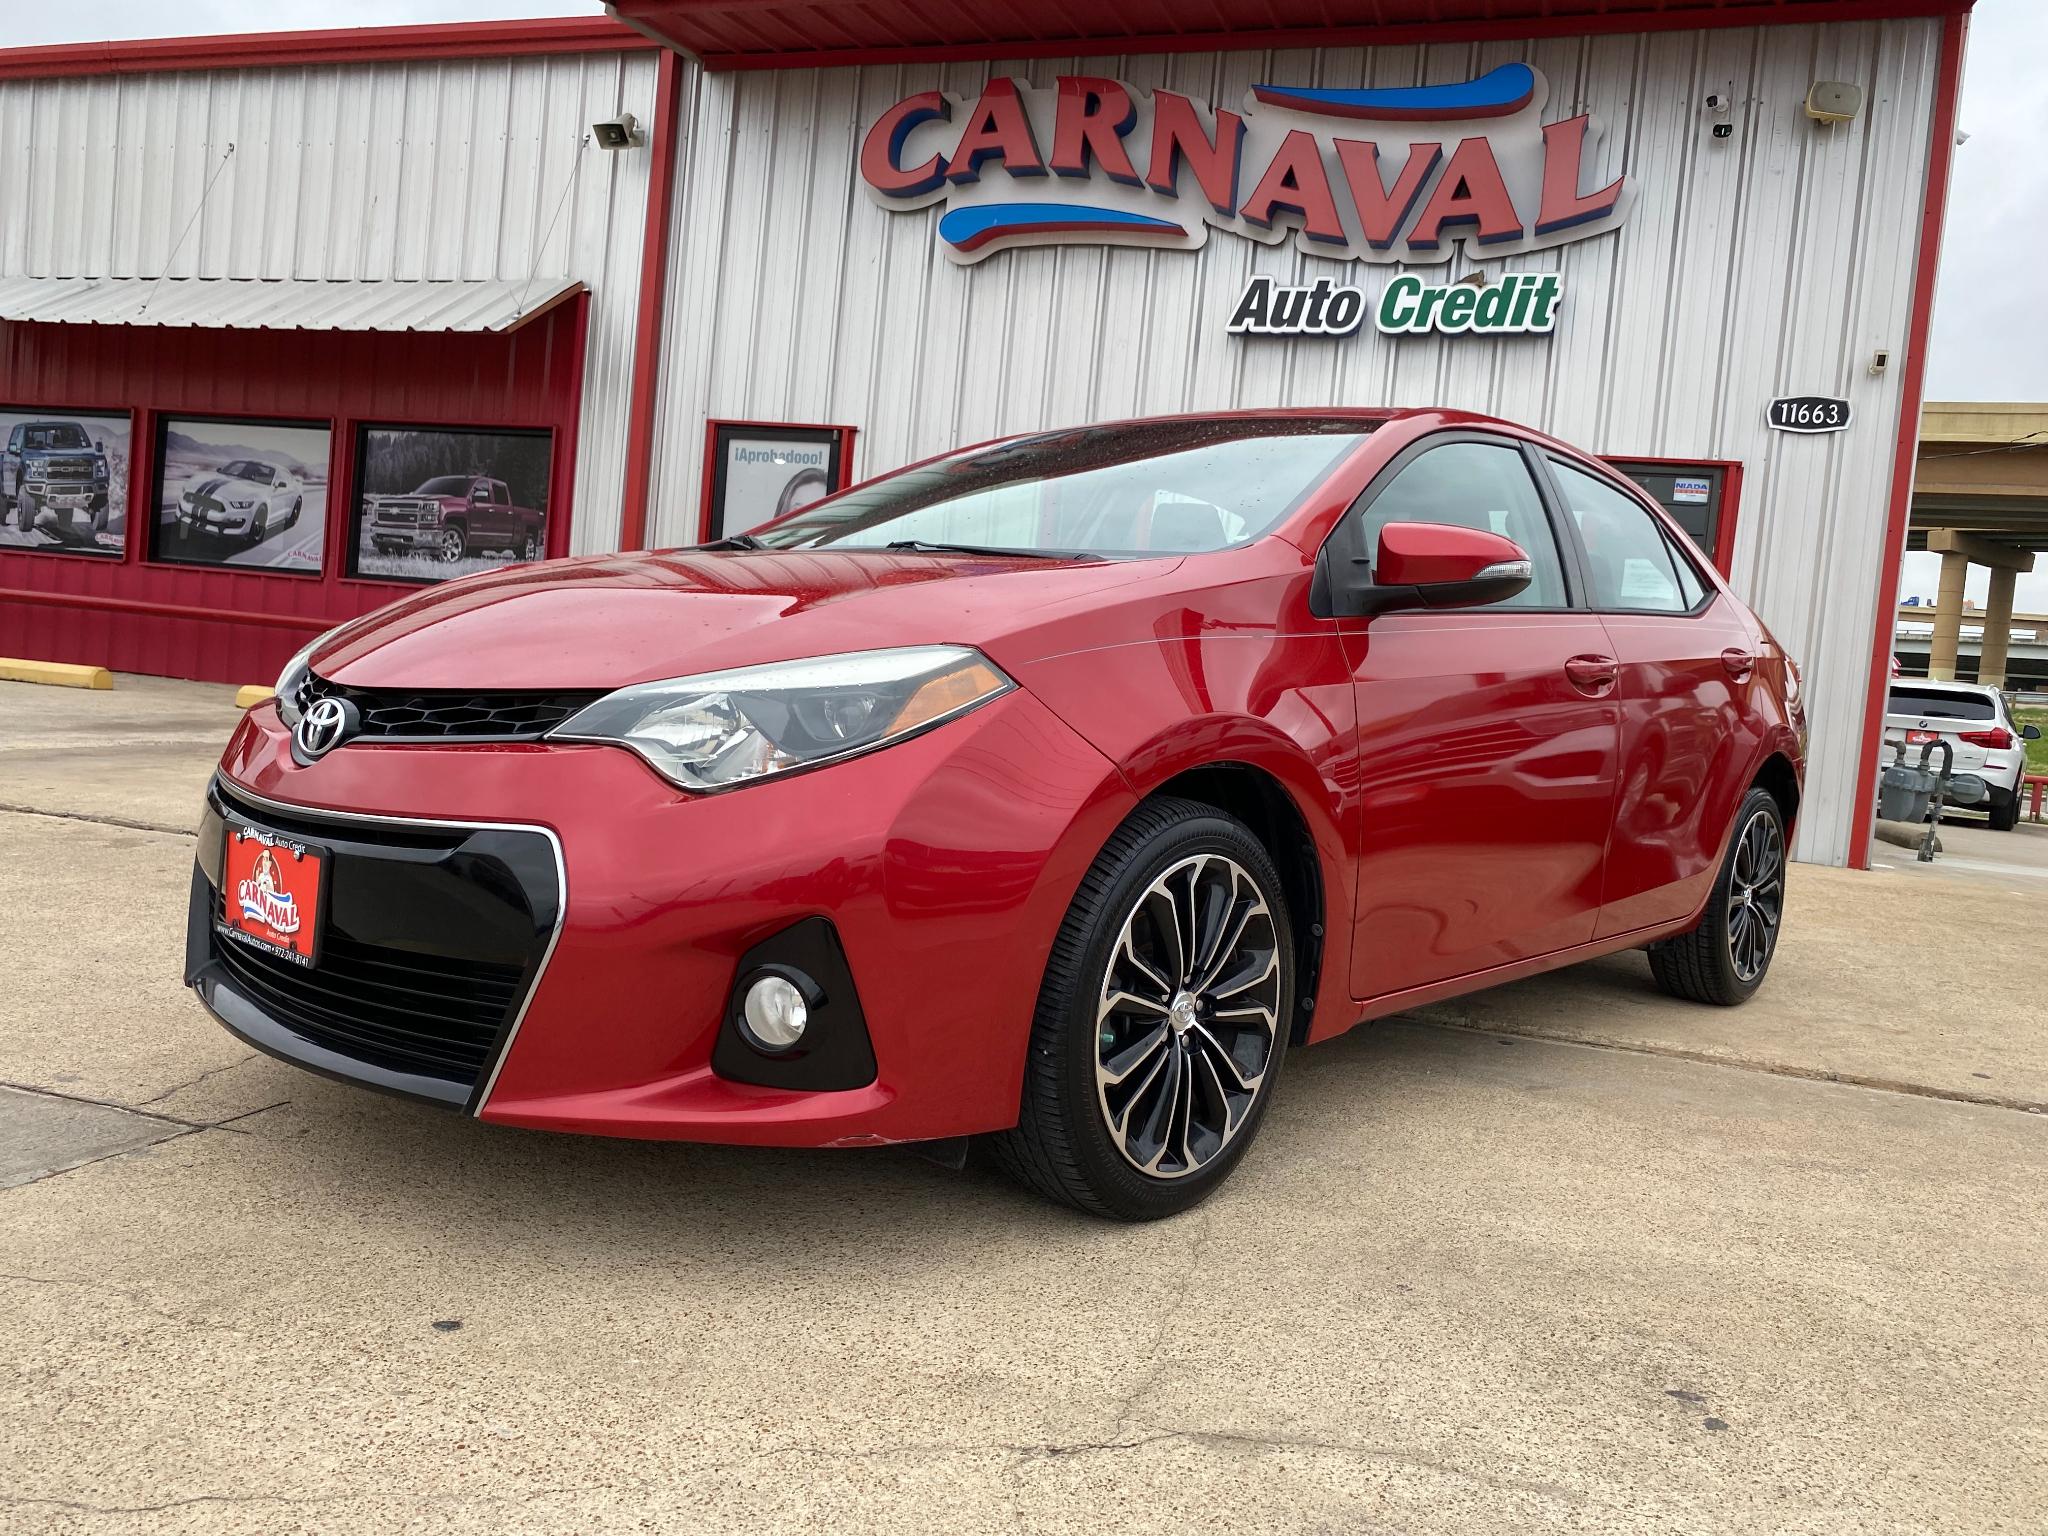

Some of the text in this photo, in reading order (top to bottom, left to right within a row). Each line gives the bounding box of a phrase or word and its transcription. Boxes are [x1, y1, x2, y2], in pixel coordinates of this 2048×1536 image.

[860, 75, 1625, 252] CARNAVAL
[1229, 275, 1559, 329] Auto Credit
[1781, 403, 1838, 424] 11663
[243, 826, 306, 854] CARNAVAL Auto Credit
[239, 881, 299, 927] CARNAVAL
